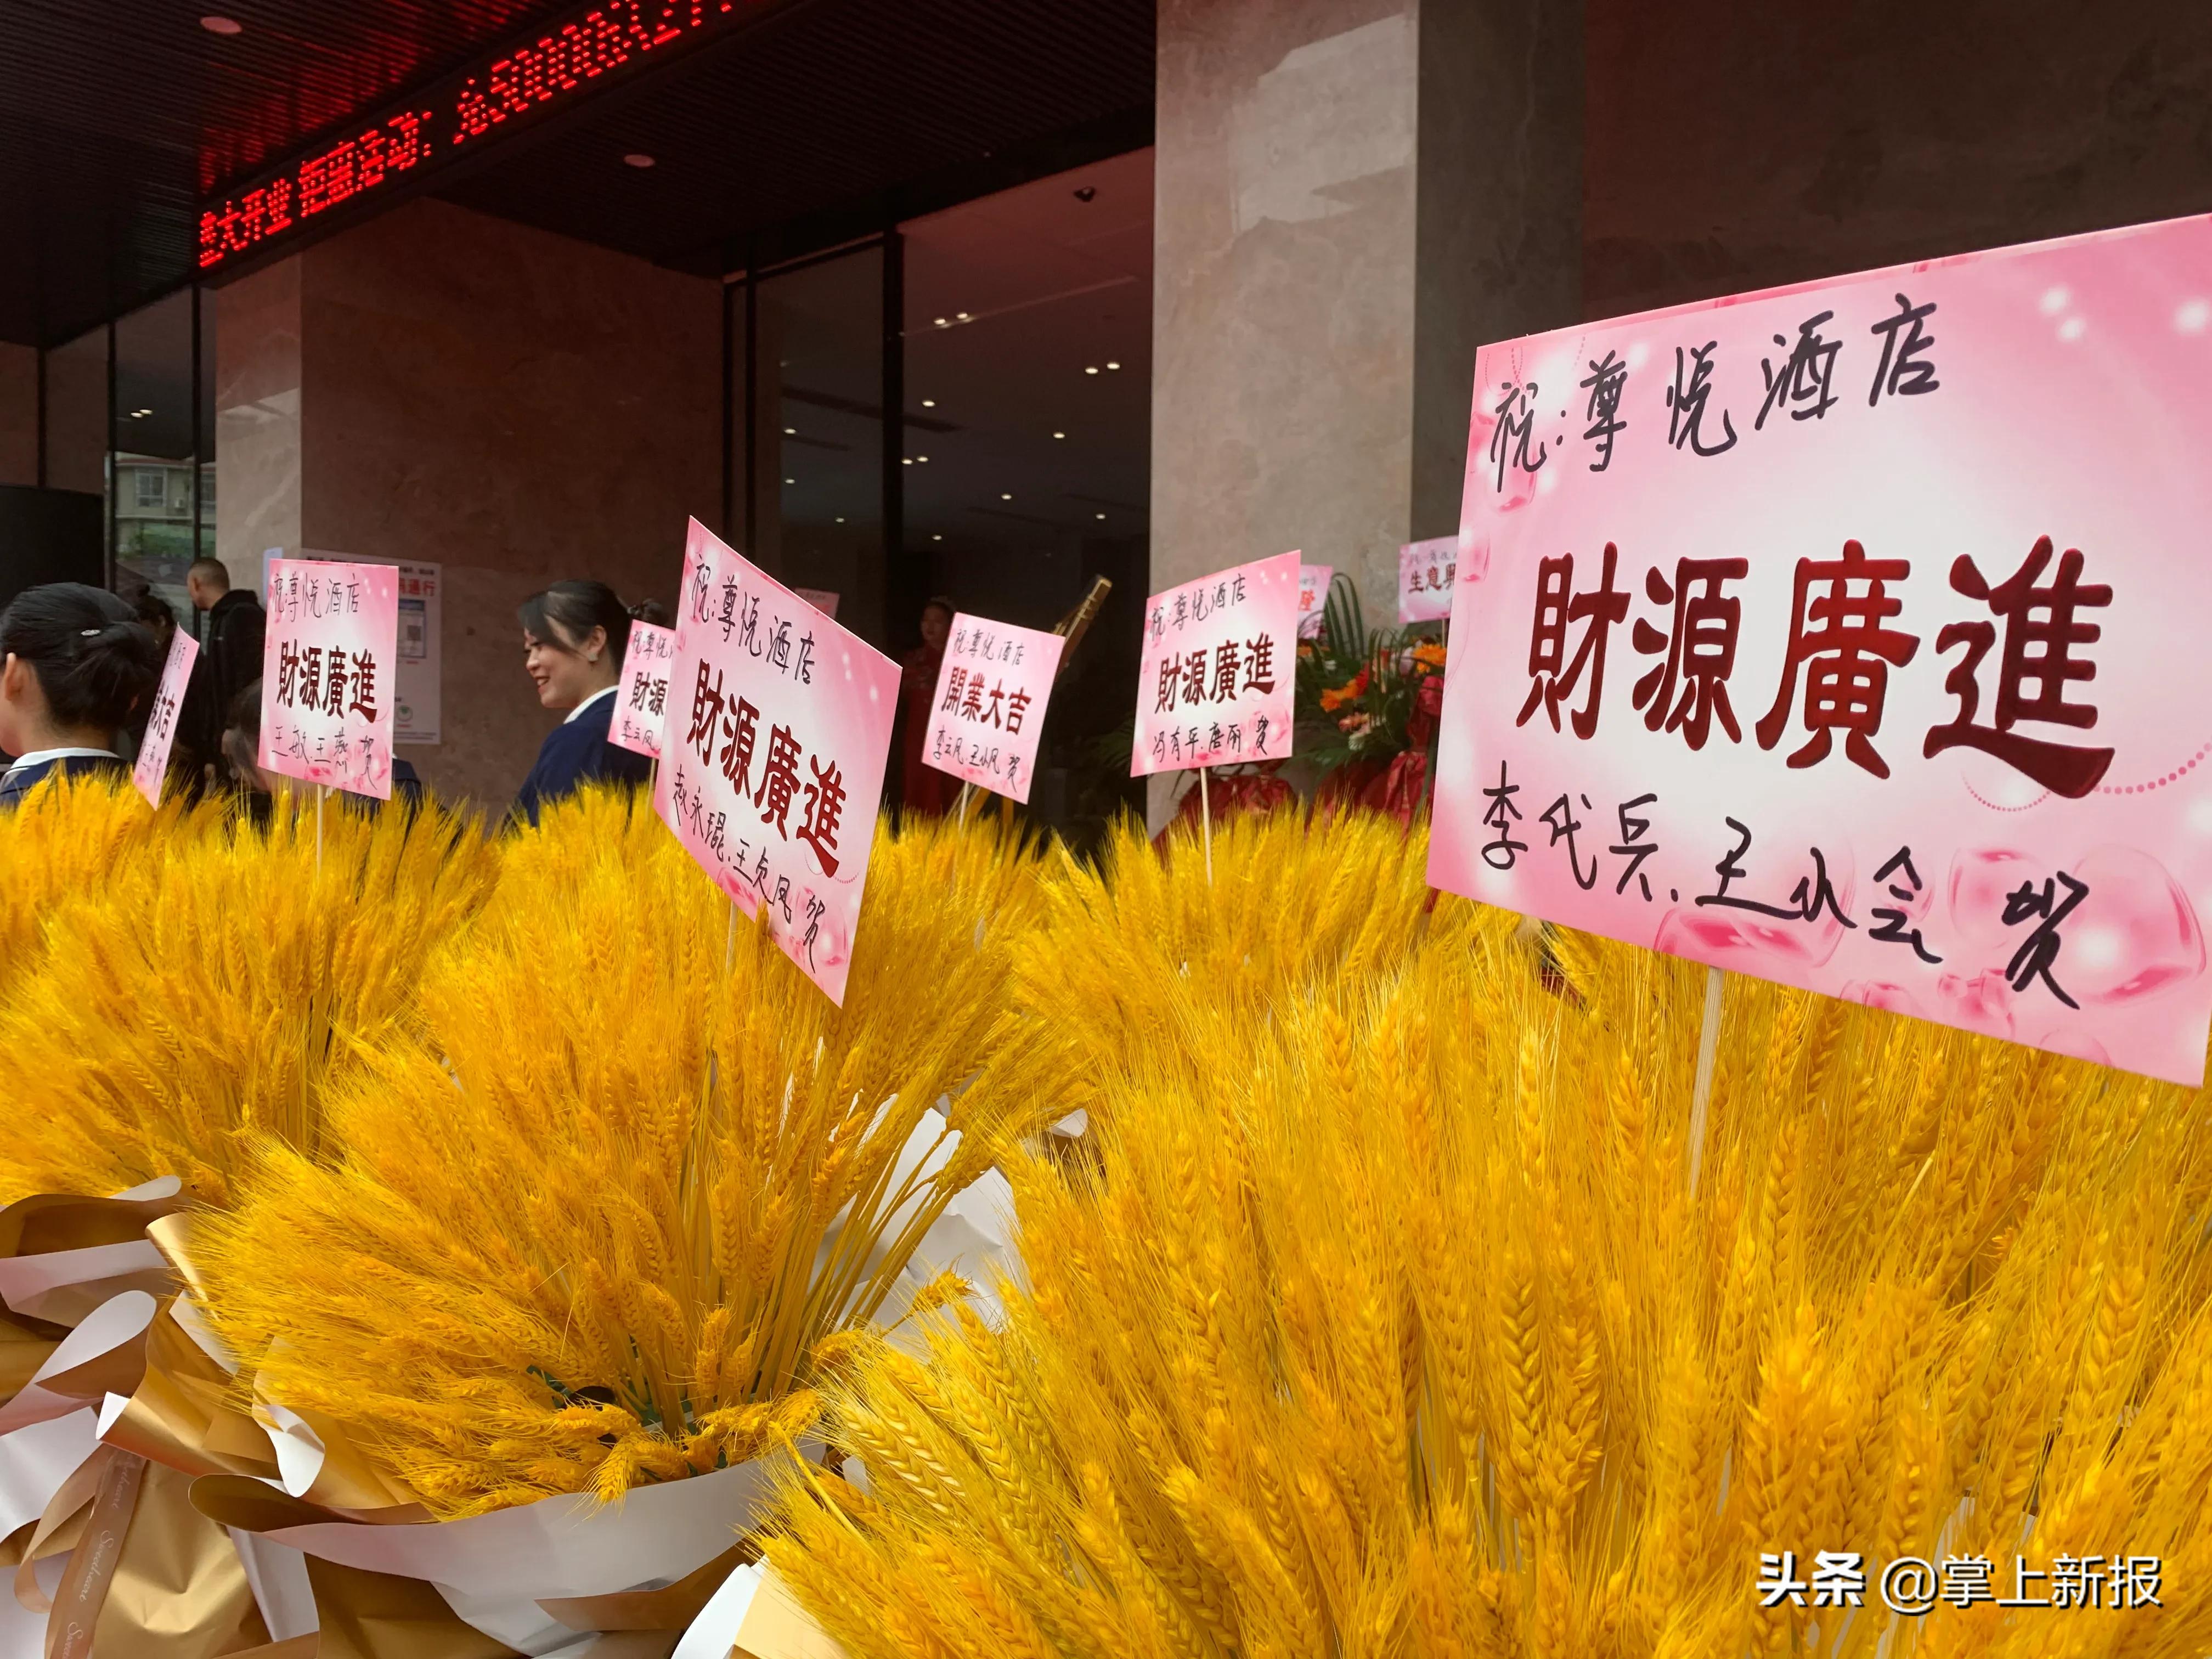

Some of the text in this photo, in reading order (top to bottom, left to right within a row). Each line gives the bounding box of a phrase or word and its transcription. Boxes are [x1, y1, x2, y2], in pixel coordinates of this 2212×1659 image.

[276, 639, 377, 723] 財源廣進
[629, 672, 668, 716] 財源
[941, 666, 1032, 735] 開業大吉
[1155, 632, 1276, 714] 財源廣進
[1516, 533, 2116, 799] 財源廣進
[687, 658, 847, 878] 財源廣進
[2001, 871, 2089, 1009] 贺
[79, 1530, 114, 1602] Sweetheart
